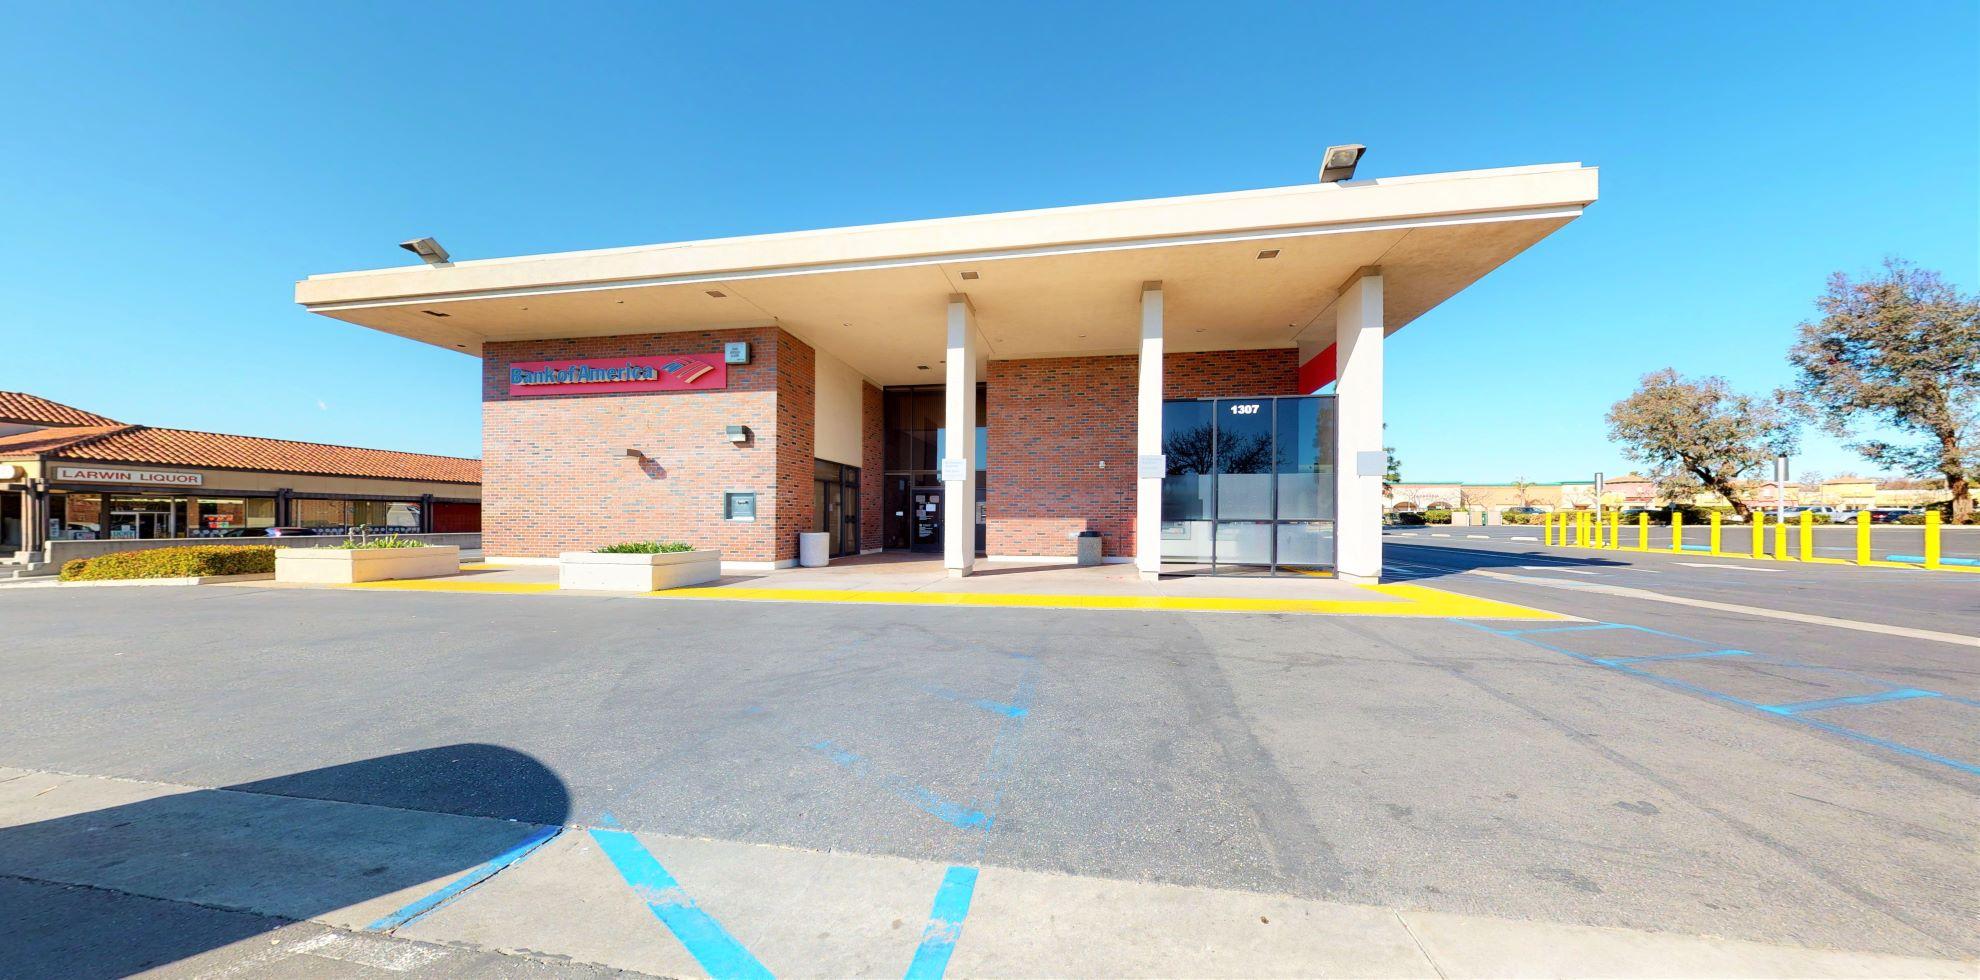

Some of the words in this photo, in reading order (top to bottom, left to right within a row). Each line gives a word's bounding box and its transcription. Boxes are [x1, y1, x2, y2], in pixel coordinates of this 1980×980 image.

[511, 366, 555, 384] Bank
[557, 365, 577, 383] of
[577, 361, 656, 382] America
[1231, 404, 1260, 415] 1307
[62, 470, 131, 481] LARWIN
[140, 473, 198, 483] LIQUOR
